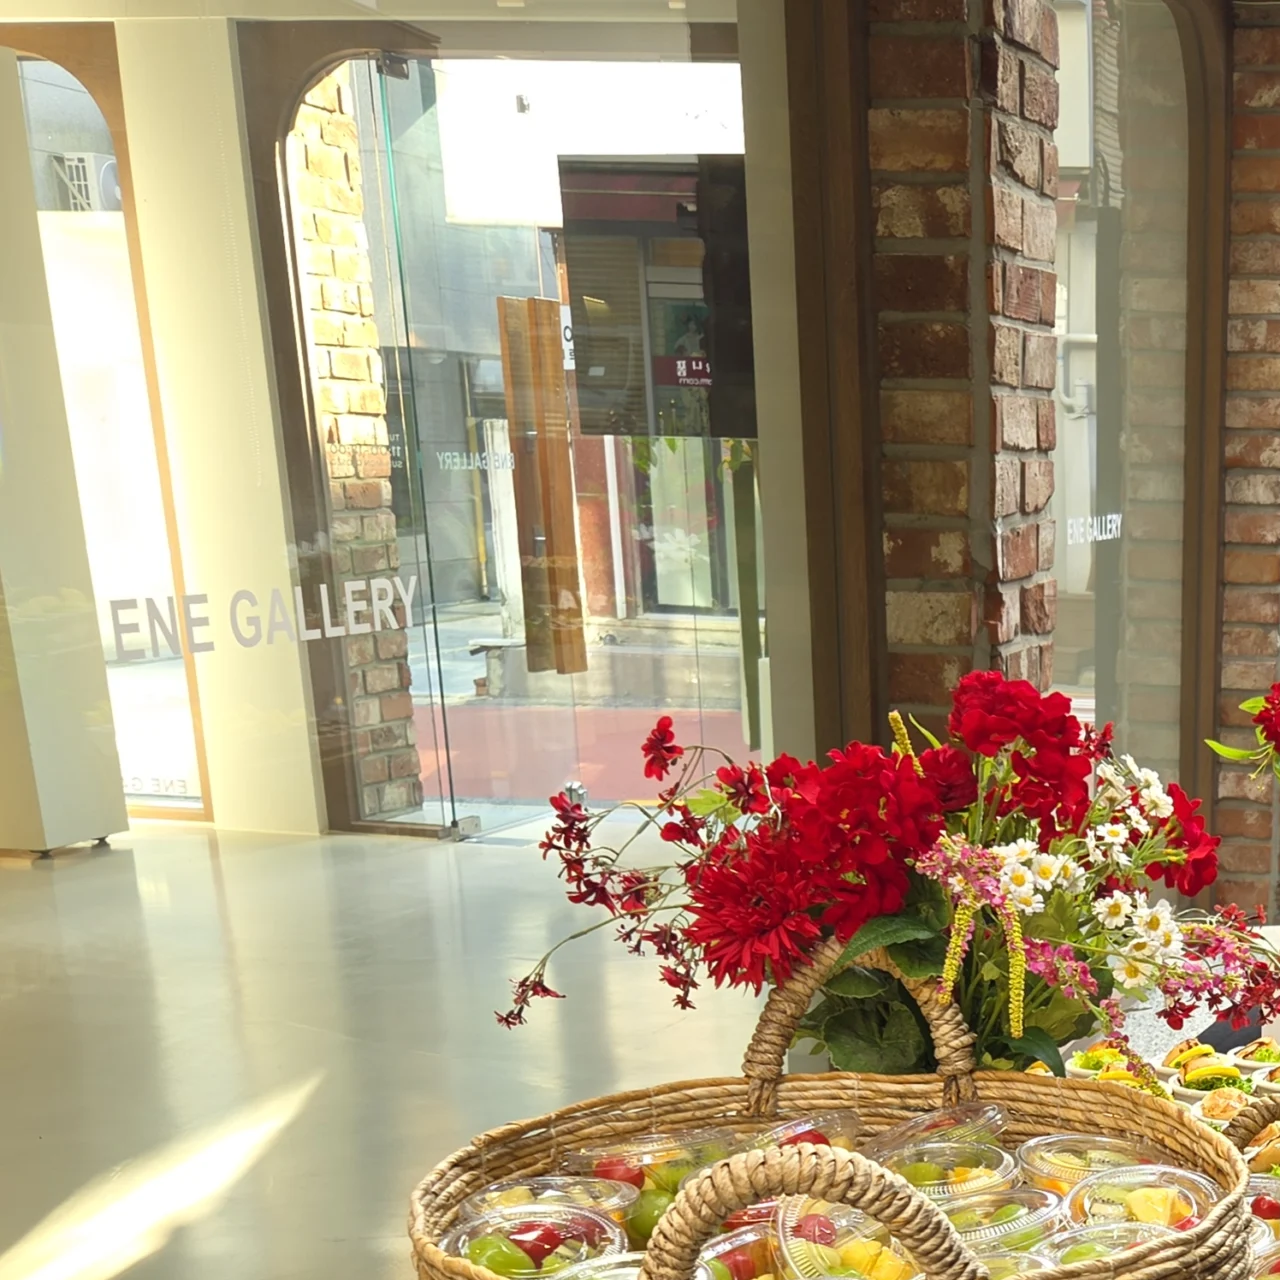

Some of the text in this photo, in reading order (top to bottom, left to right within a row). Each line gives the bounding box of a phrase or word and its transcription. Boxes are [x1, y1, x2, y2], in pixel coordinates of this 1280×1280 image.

[1067, 513, 1122, 545] ENE GALLERY
[109, 575, 417, 662] ENE GALLERY
